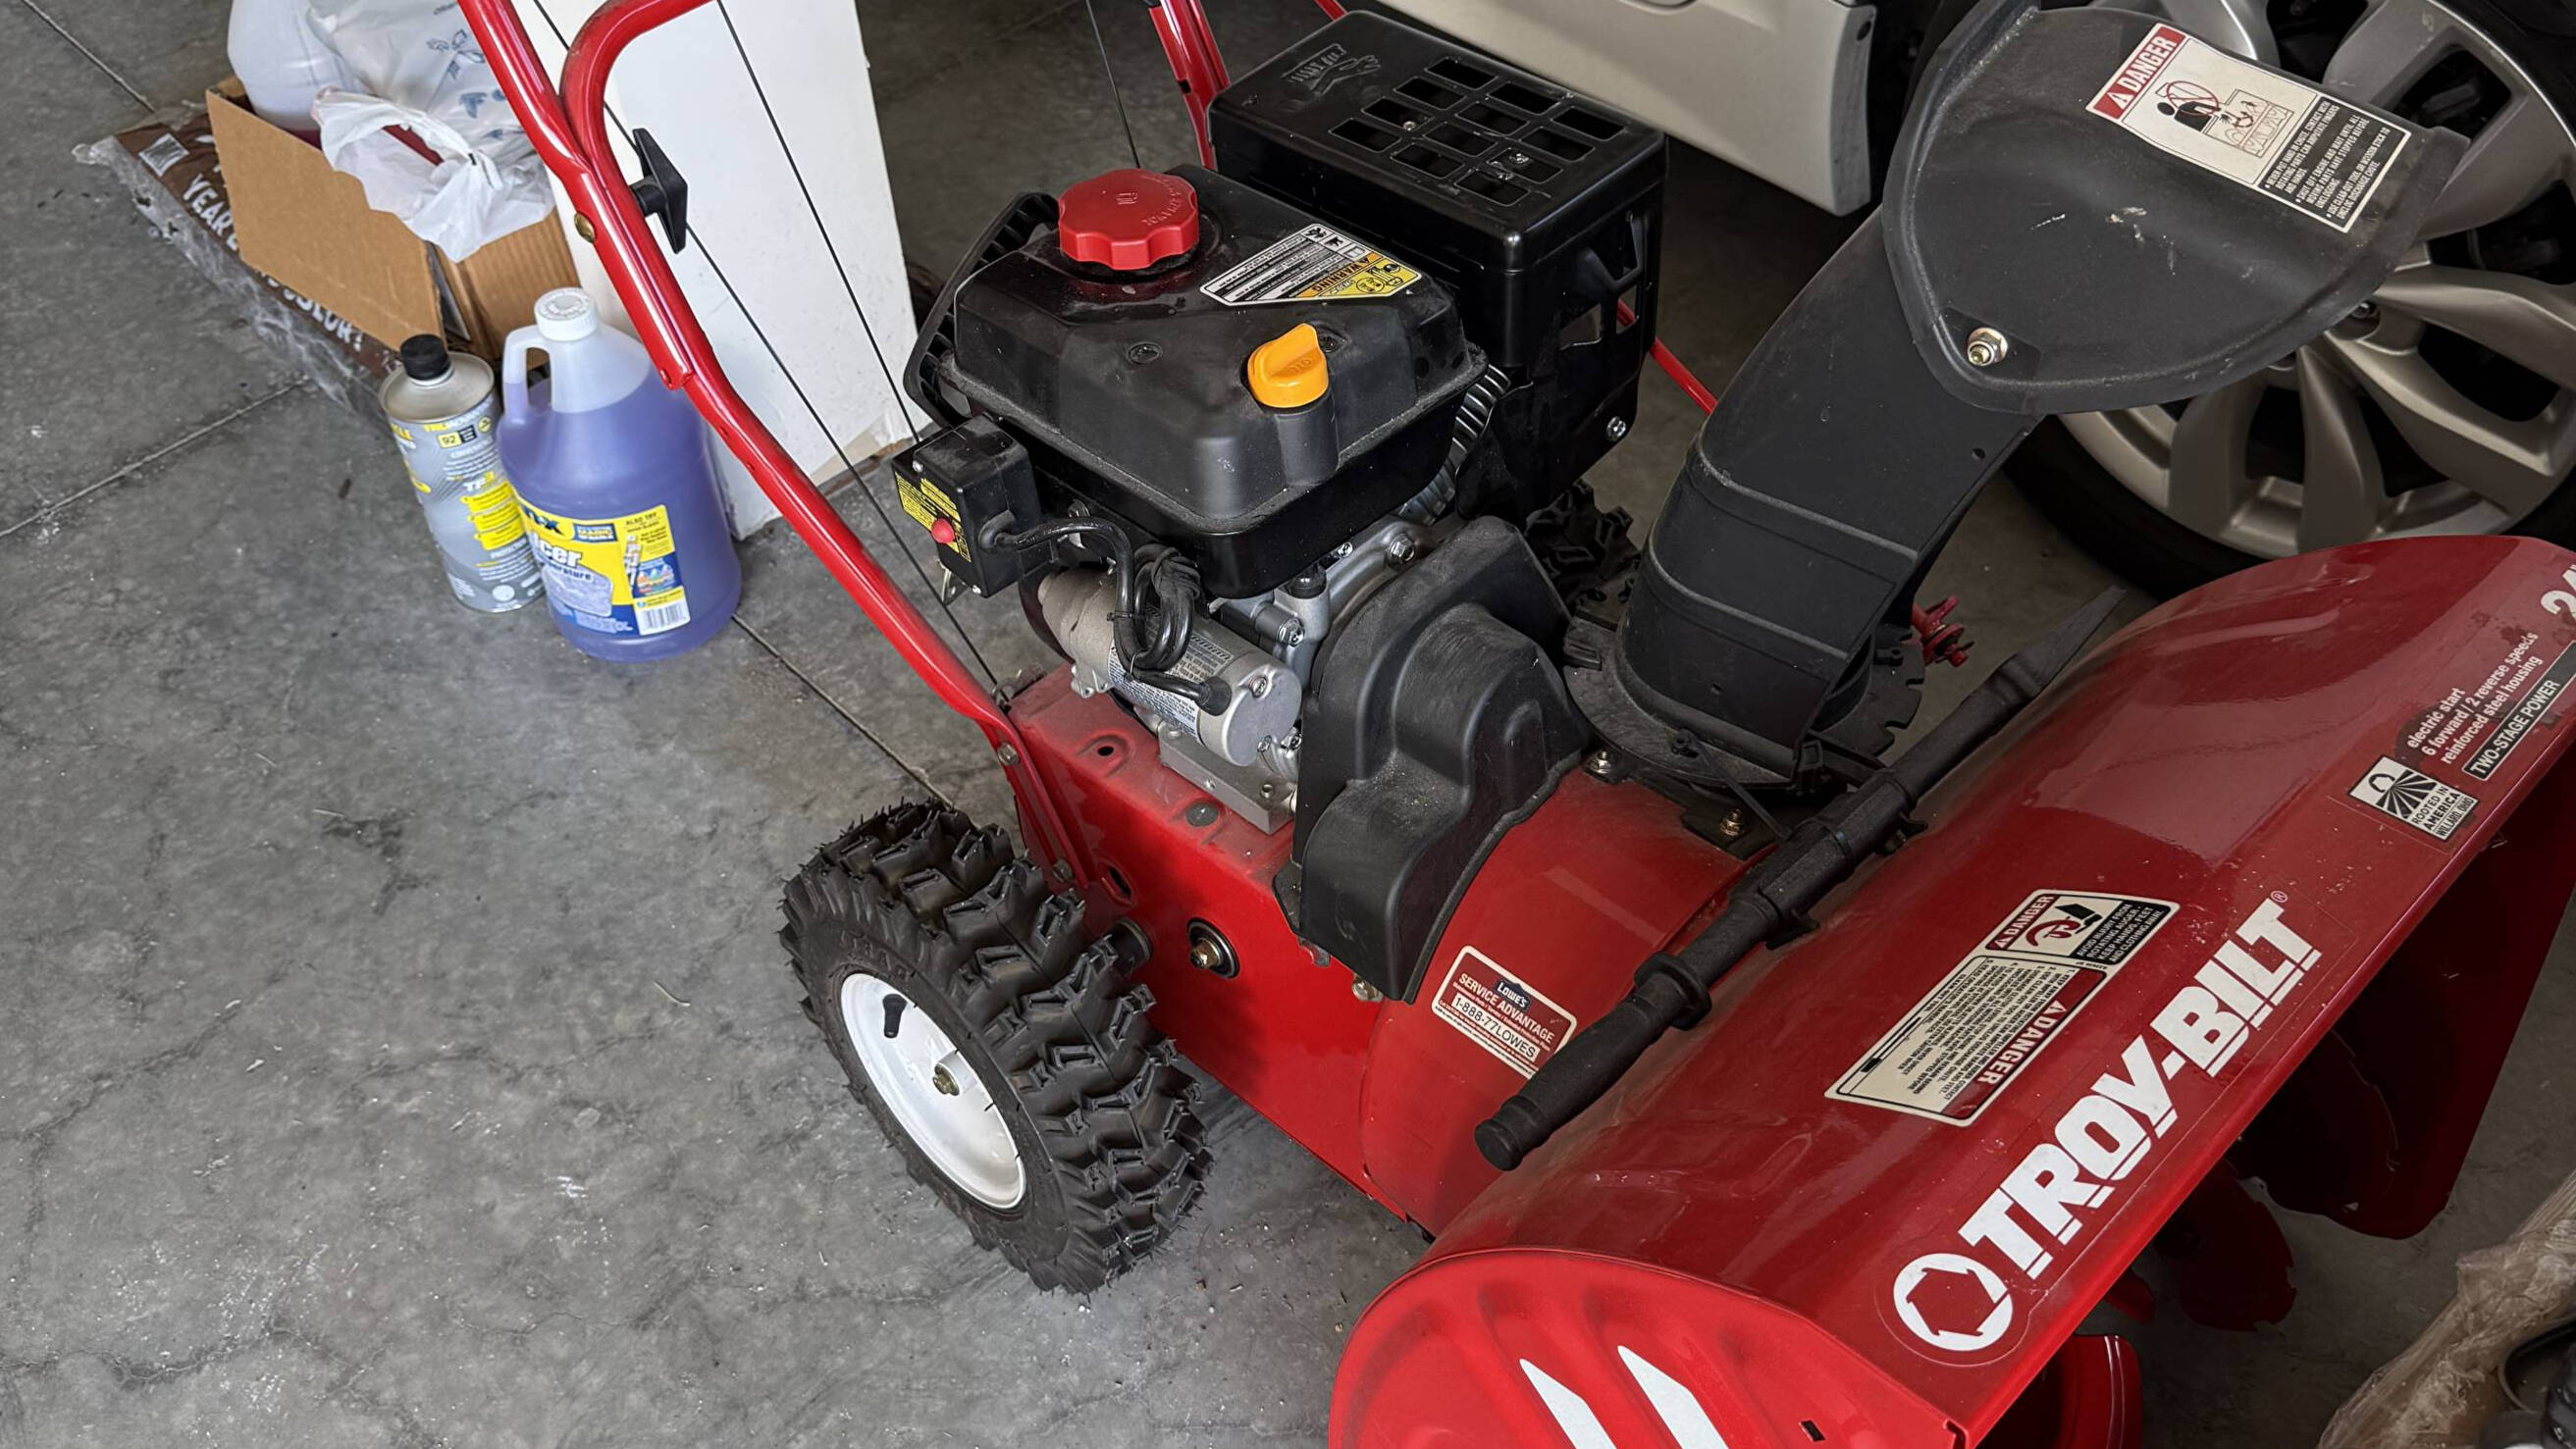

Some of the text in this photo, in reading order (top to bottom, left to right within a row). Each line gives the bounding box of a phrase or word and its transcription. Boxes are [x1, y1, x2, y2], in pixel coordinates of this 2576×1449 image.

[2117, 35, 2177, 92] DANGER
[1312, 265, 1360, 293] WARNING
[442, 435, 456, 444] 92
[2503, 632, 2538, 665] speeds
[2473, 664, 2509, 699] reverse
[2406, 687, 2465, 748] electric start
[2441, 655, 2543, 763] reinforced steel housing
[2466, 697, 2481, 706] 2
[2427, 708, 2469, 748] forward
[2469, 714, 2528, 773] TWO-STAGE
[2519, 679, 2559, 717] POWER
[2421, 746, 2436, 755] 6
[2410, 785, 2448, 824] ROOTED IN
[2423, 792, 2460, 830] AMERICA
[2004, 897, 2054, 934] DANGER
[2076, 939, 2096, 956] AVOID
[2092, 919, 2115, 939] INJURY
[2111, 904, 2131, 919] FROM
[2096, 943, 2116, 959] KEEP
[2133, 906, 2153, 921] FEET
[2085, 929, 2119, 957] ROTATING
[2108, 950, 2124, 961] AND
[1458, 972, 1498, 1006] SERVICE
[1496, 1000, 1554, 1043] ADVANTAGE
[1497, 981, 1527, 1008] LOWE'S
[1455, 997, 1536, 1058] 1-888-77LOWES
[1977, 1015, 2057, 1084] DANGER
[1958, 898, 2322, 1280] TROY-BILT
